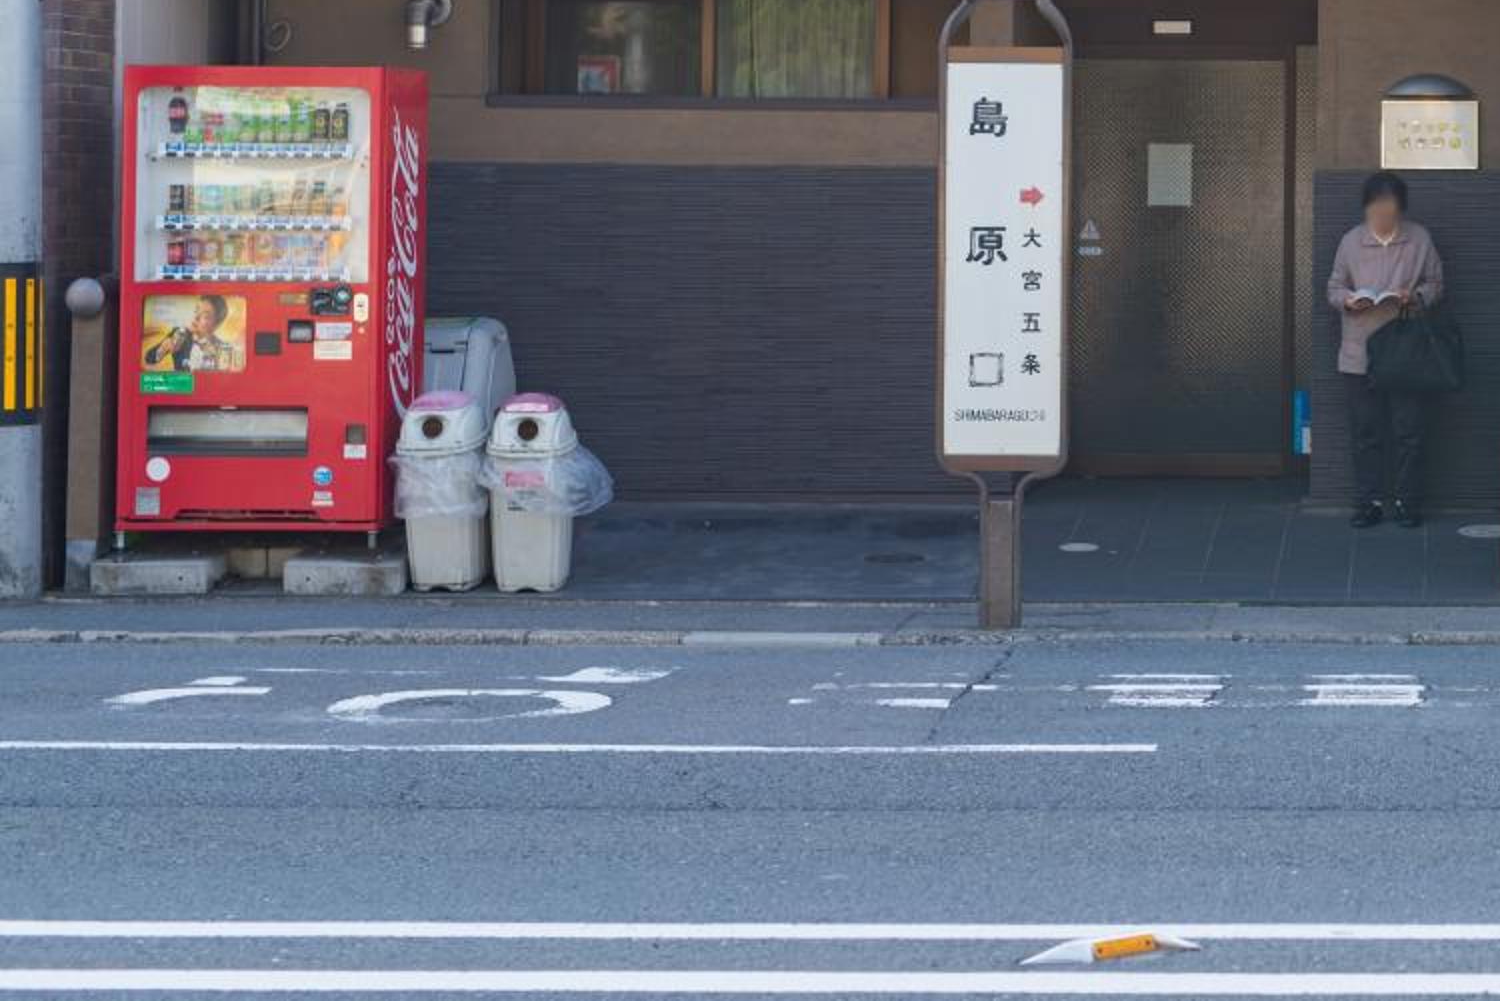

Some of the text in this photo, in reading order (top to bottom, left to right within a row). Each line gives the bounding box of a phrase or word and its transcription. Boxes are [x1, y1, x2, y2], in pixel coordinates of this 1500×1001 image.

[388, 105, 419, 420] Coca-Cola
[1021, 228, 1043, 375] 大宮五条
